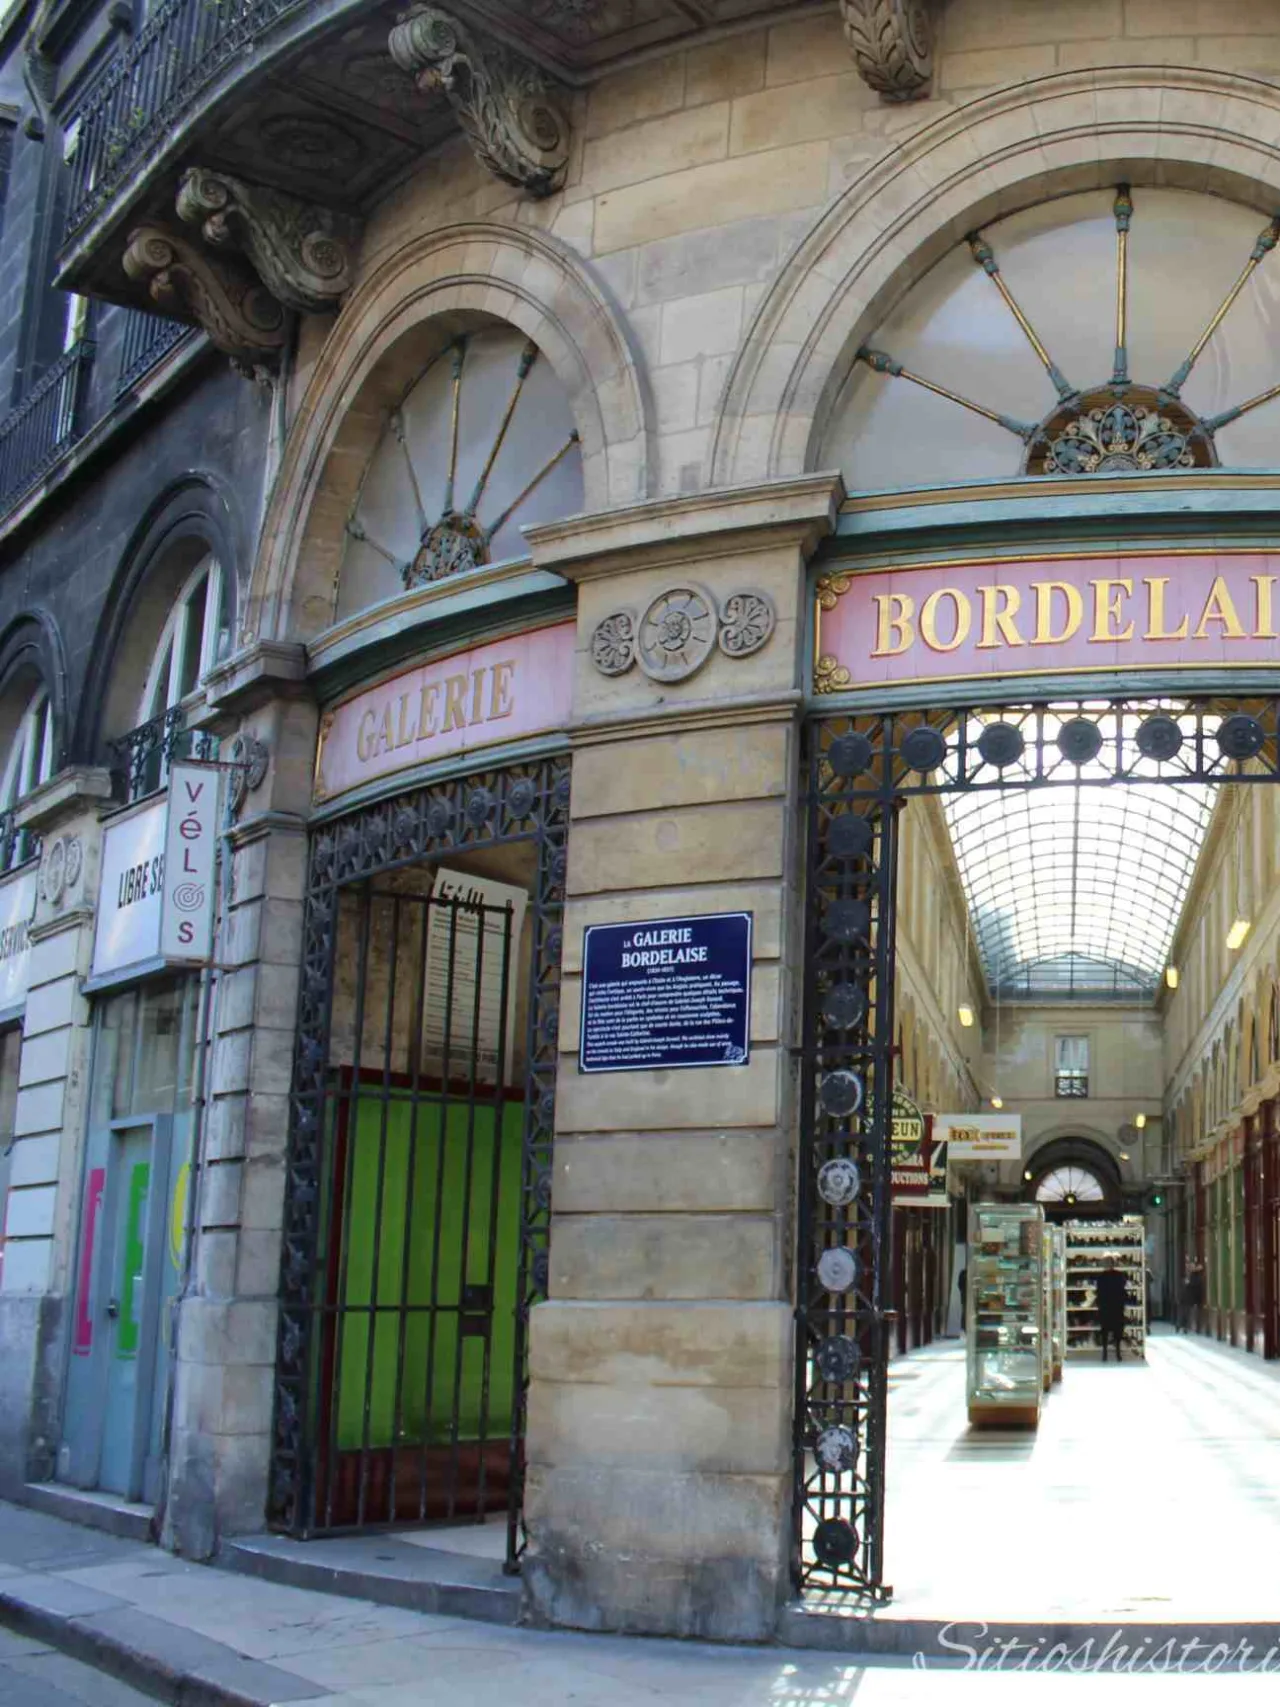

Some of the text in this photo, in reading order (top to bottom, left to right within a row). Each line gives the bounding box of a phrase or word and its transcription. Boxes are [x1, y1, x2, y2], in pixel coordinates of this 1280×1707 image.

[356, 659, 518, 763] GALERIE
[118, 858, 150, 909] LIBRE
[623, 928, 692, 948] LA GALERIE
[621, 946, 708, 968] BORDELAISE
